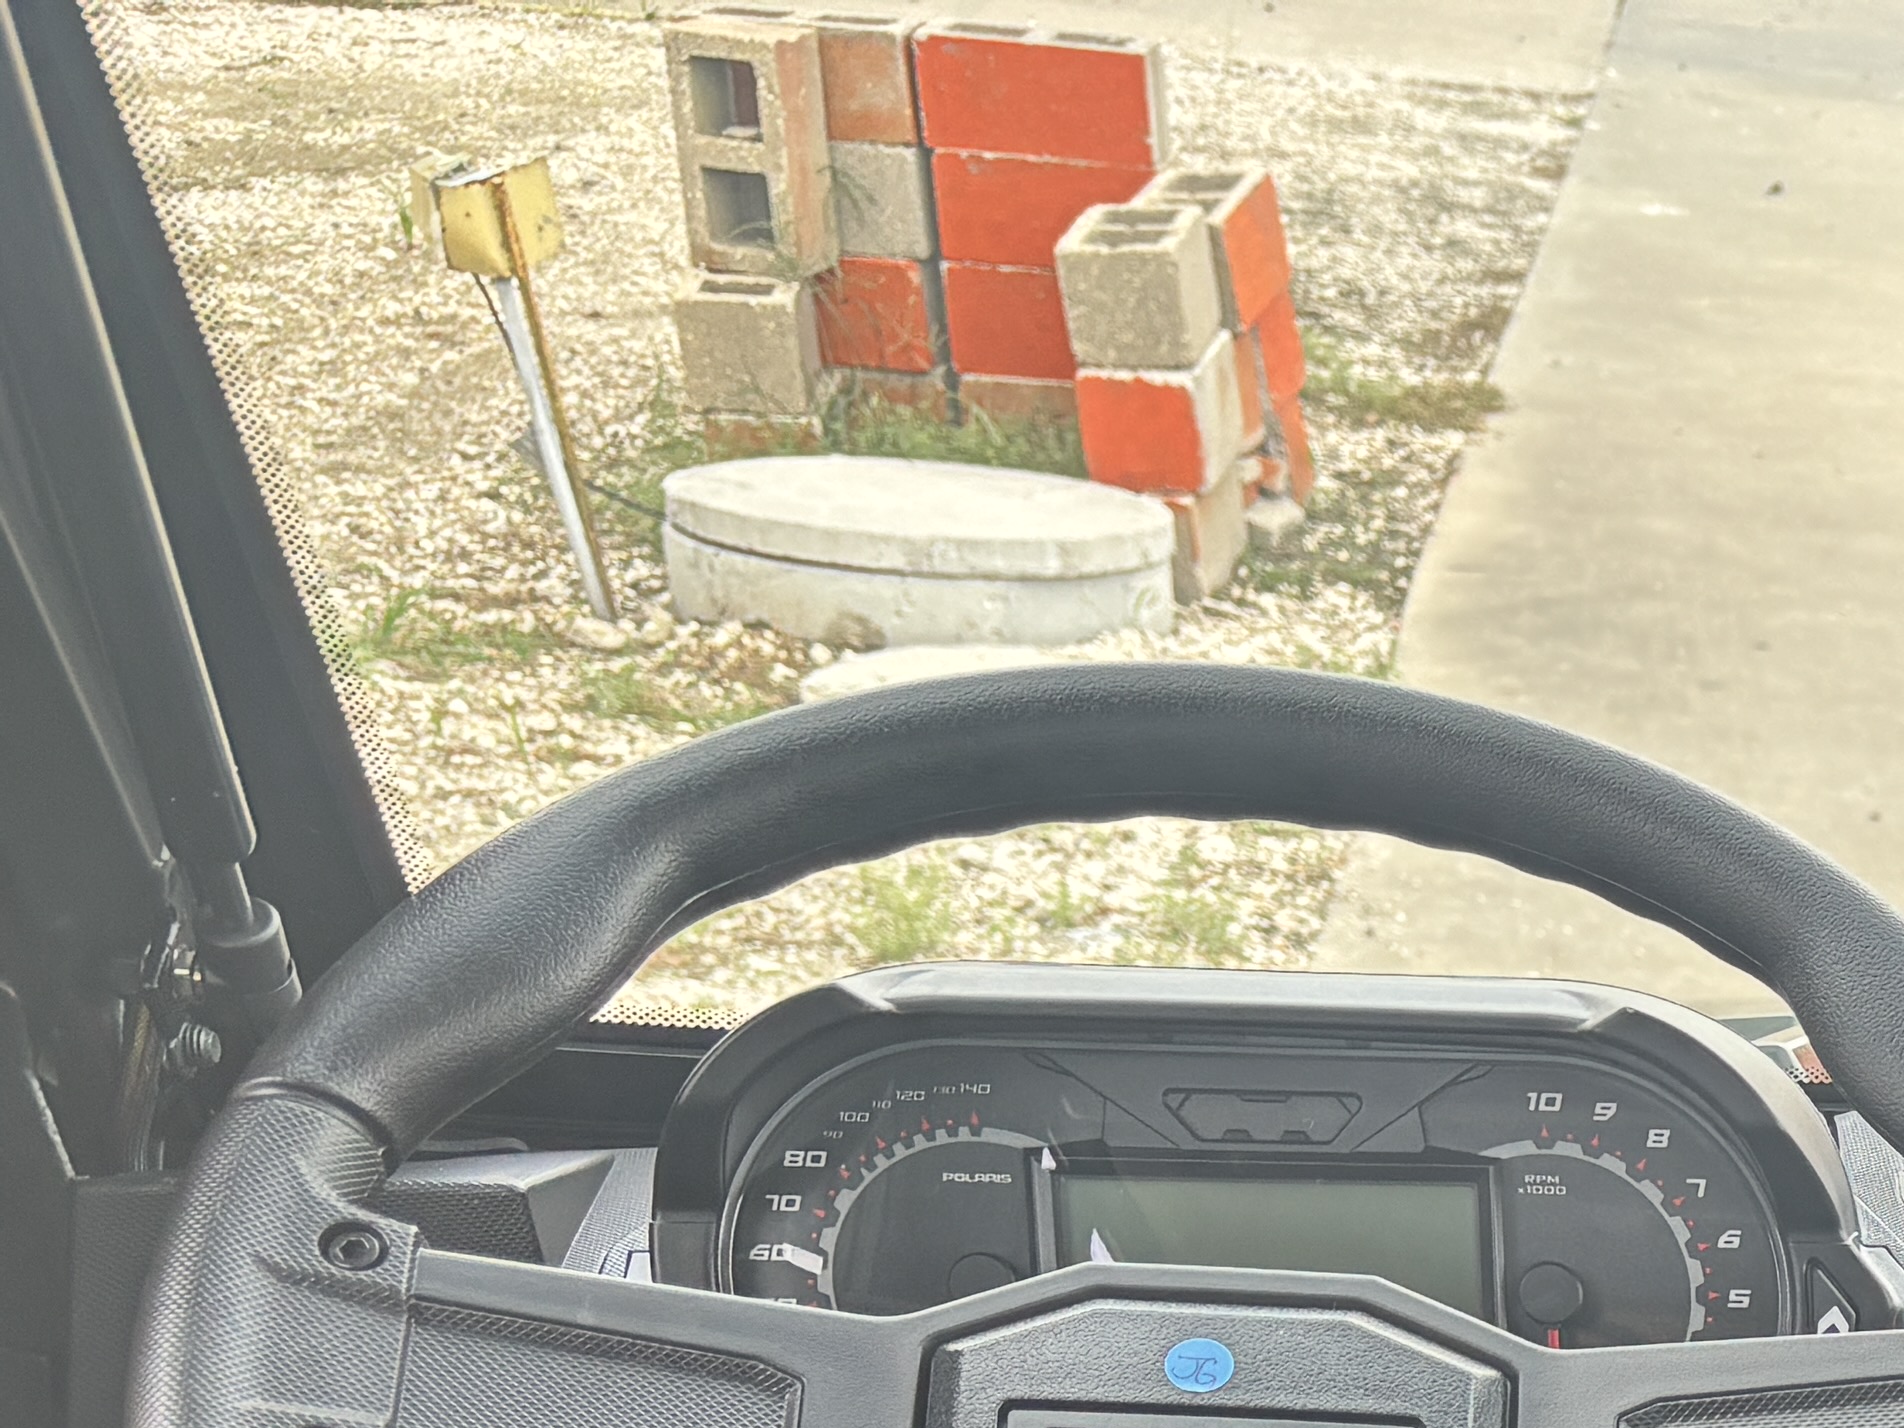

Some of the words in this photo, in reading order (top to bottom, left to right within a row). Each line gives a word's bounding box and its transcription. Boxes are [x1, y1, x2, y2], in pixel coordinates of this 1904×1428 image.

[896, 1090, 926, 1101] 120
[959, 1082, 991, 1095] 140
[1526, 1092, 1563, 1112] 10
[839, 1111, 870, 1123] 100
[1593, 1102, 1617, 1121] 9
[1646, 1129, 1671, 1148] 8
[783, 1150, 828, 1168] 80
[943, 1172, 1012, 1184] POLARIS
[1524, 1174, 1560, 1185] RPM
[1686, 1178, 1707, 1198] 7
[765, 1195, 802, 1212] 70
[1717, 1230, 1742, 1249] 6
[1727, 1289, 1752, 1308] 5
